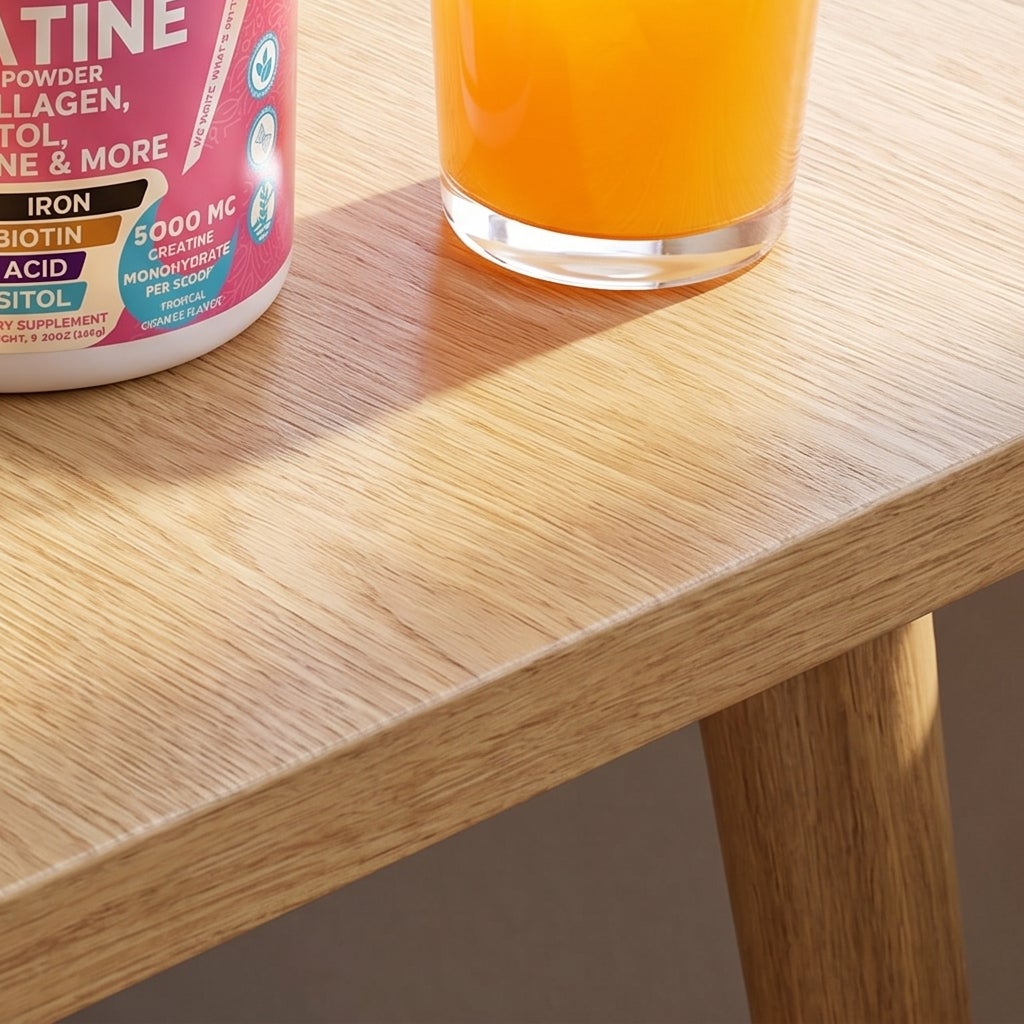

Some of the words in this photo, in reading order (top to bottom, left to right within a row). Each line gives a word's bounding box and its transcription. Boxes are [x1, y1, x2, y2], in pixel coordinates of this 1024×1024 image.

[1, 65, 103, 88] POWDER
[49, 153, 72, 175] &
[81, 134, 169, 172] MORE
[27, 193, 91, 216] IRON
[134, 210, 201, 247] 5000
[148, 230, 215, 261] CREATINE
[4, 259, 68, 280] ACID
[123, 241, 231, 286] MONOHYDRATE
[145, 281, 170, 297] PER
[17, 312, 108, 331] SUPPLEMENT
